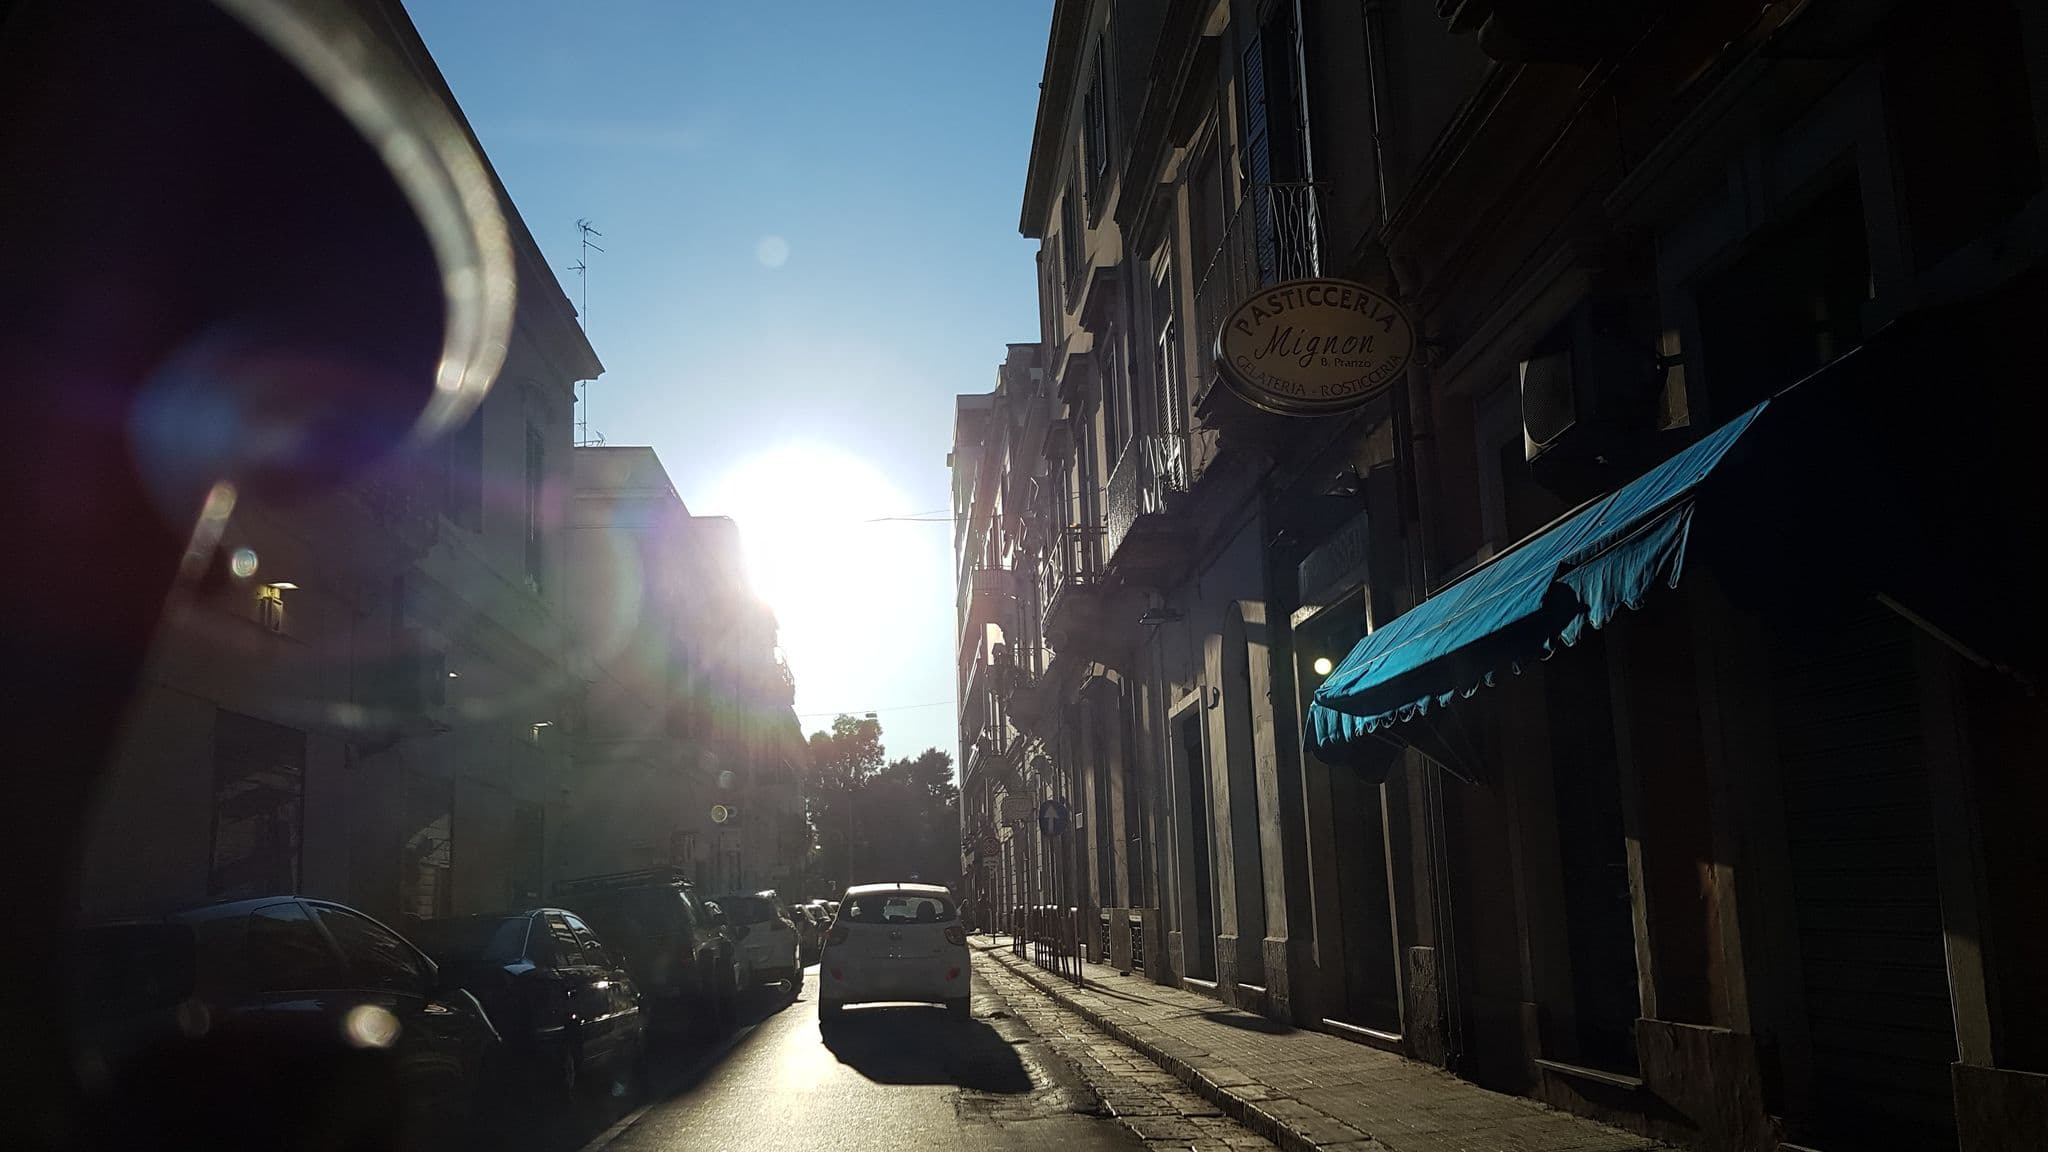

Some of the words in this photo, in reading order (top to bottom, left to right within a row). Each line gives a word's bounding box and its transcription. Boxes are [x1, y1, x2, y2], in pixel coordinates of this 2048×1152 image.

[1235, 286, 1394, 336] PASTICCERIA
[1255, 325, 1374, 368] Mignon
[1335, 358, 1371, 367] Pranzo
[1237, 355, 1306, 396] GELATERIA
[1320, 355, 1401, 397] ROSTICCERIA
